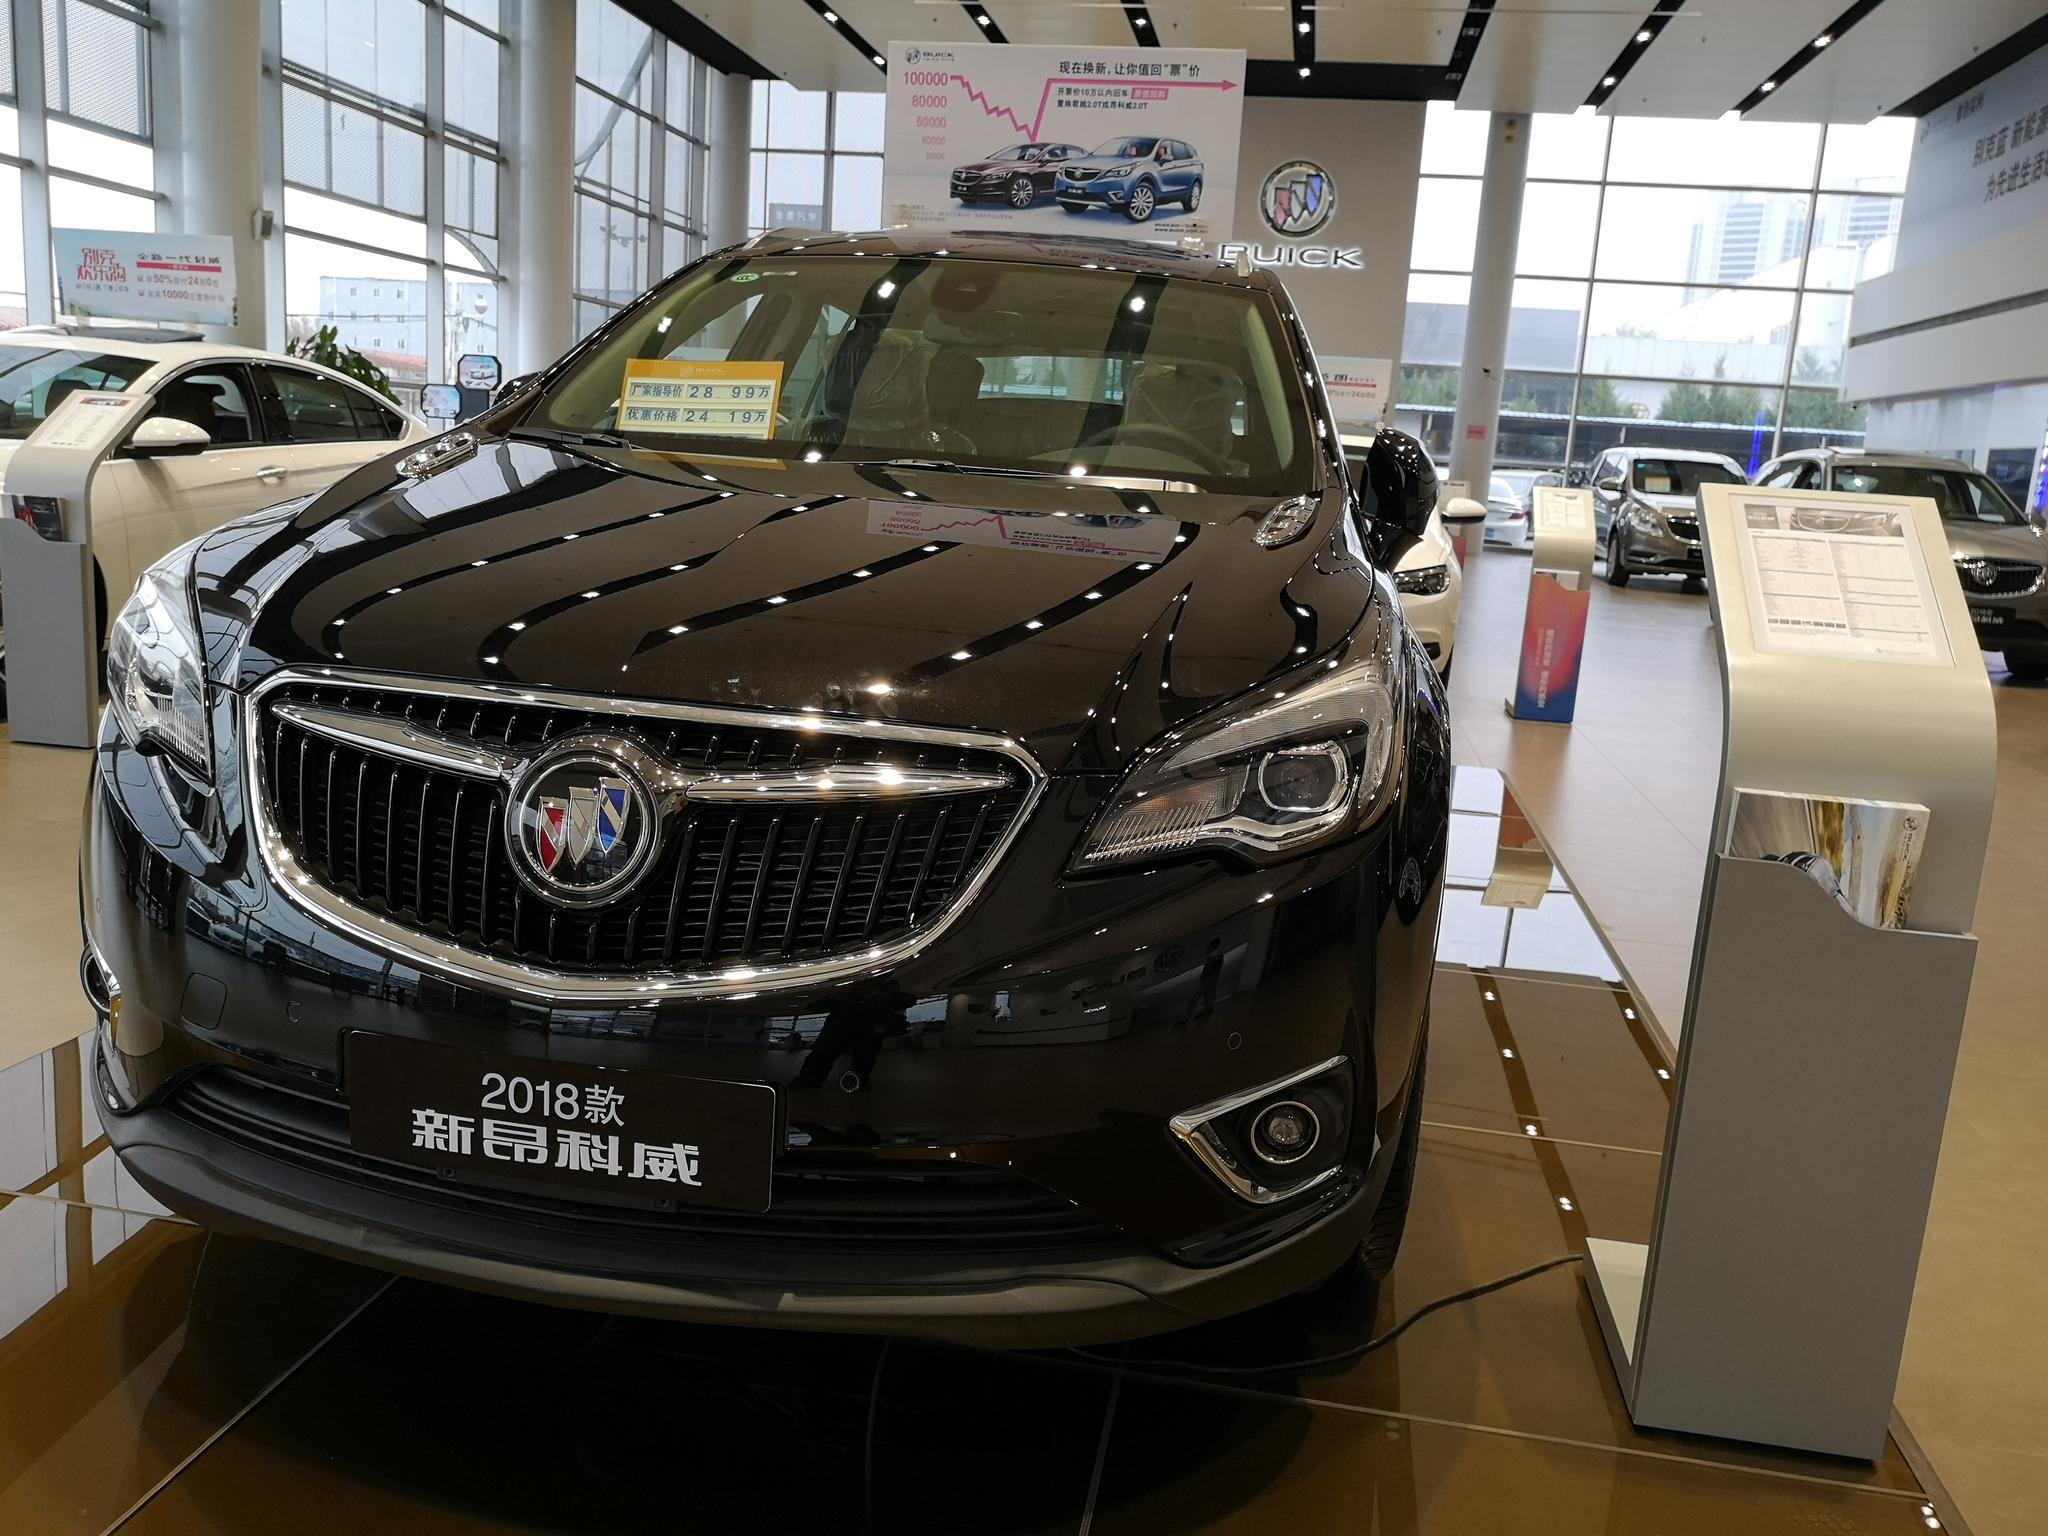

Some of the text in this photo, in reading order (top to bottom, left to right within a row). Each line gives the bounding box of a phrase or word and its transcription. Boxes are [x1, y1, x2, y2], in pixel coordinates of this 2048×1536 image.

[904, 72, 948, 86] 100000
[912, 95, 947, 108] 80000
[916, 116, 946, 128] 60000
[1220, 243, 1363, 269] BUICK
[631, 384, 682, 398] 厂家指导价
[627, 408, 678, 422] 优惠价格
[481, 1072, 625, 1127] 2018款
[412, 1108, 703, 1187] 新昂科威
